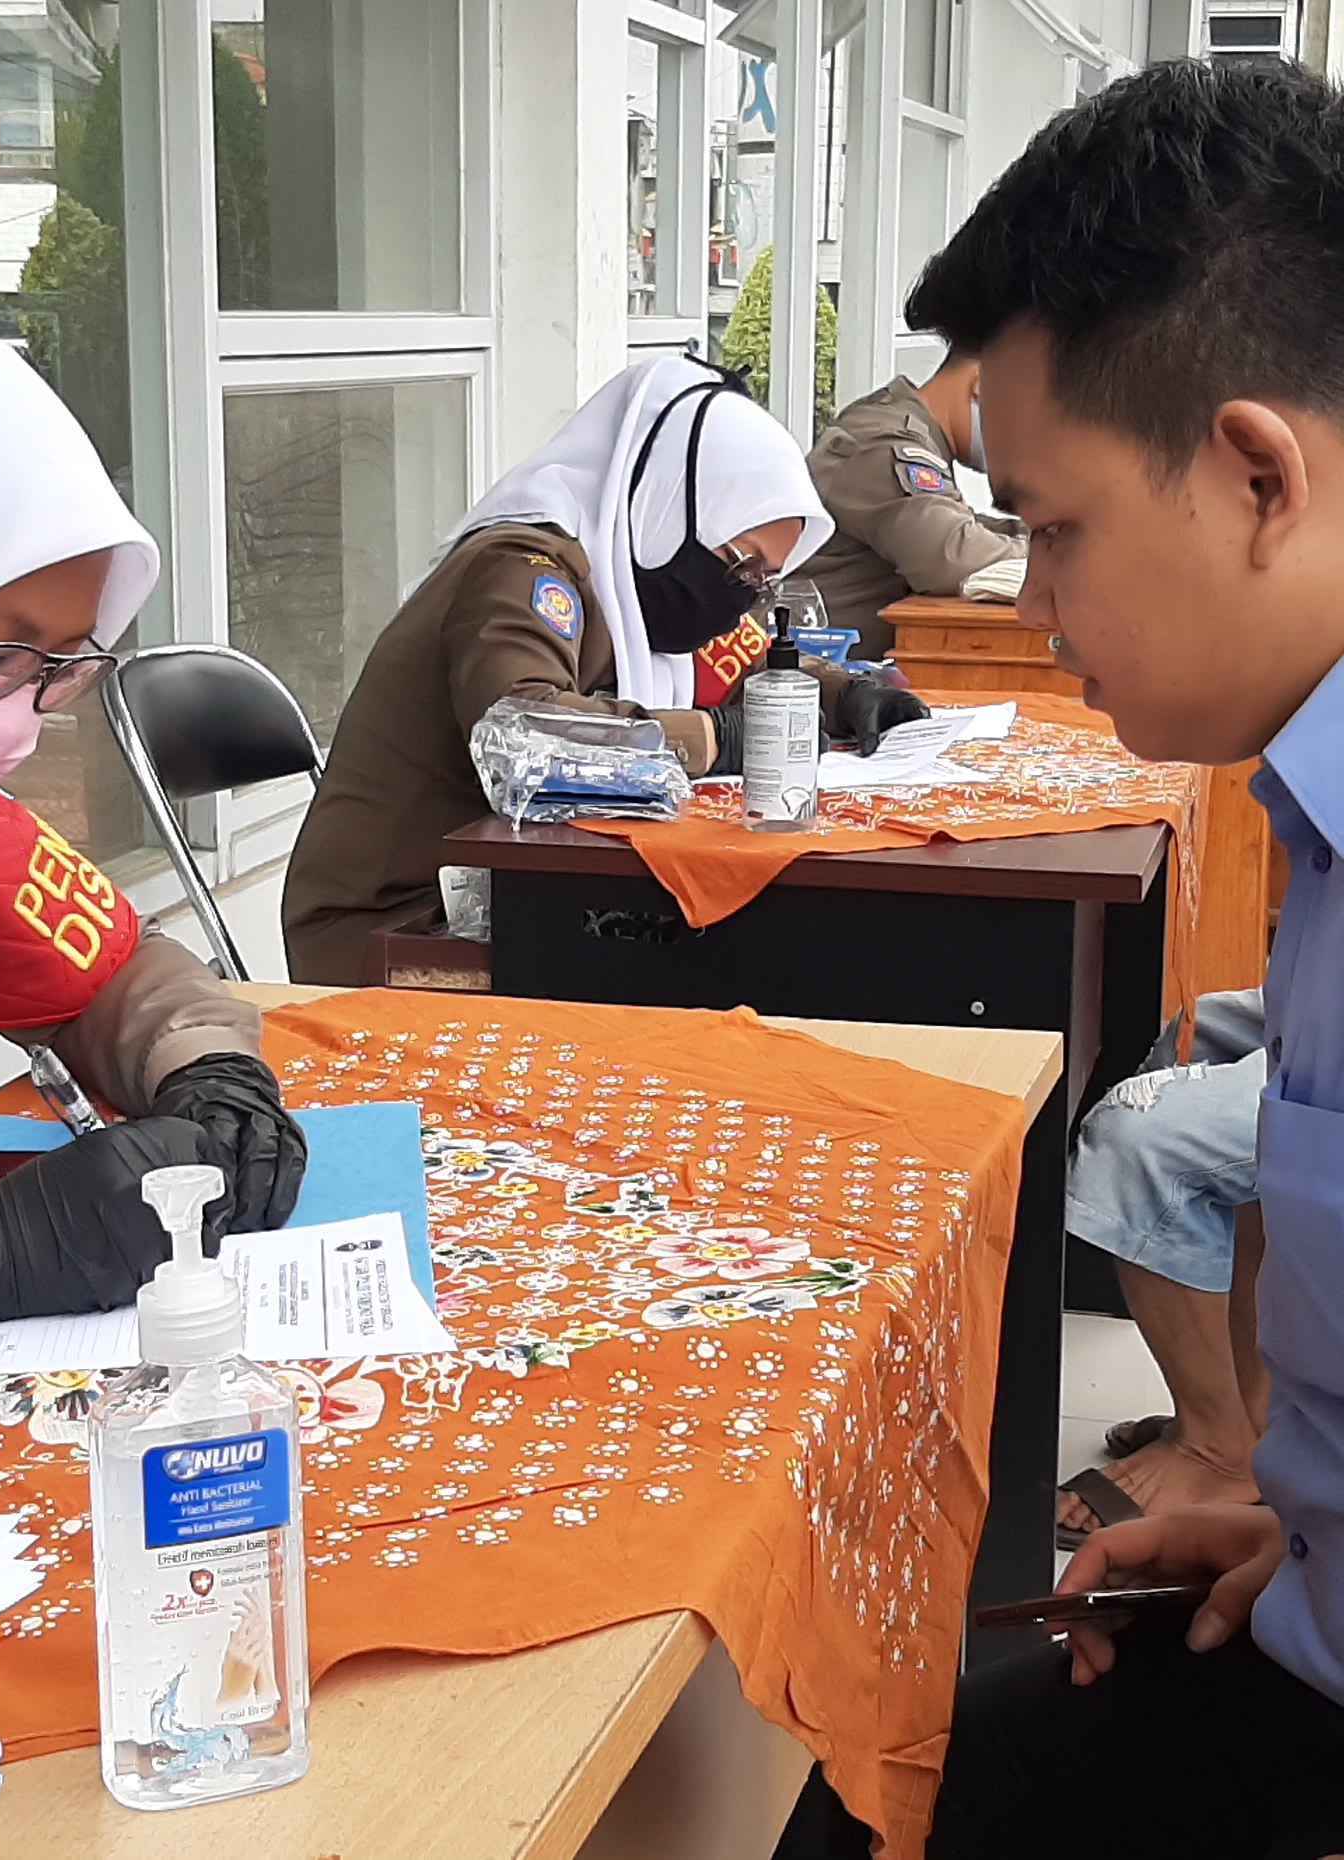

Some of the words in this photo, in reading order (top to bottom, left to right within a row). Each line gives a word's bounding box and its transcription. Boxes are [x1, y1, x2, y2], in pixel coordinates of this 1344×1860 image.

[193, 1441, 264, 1472] NUVO
[169, 1490, 200, 1504] ANTI
[202, 1480, 263, 1501] BACTERIAL
